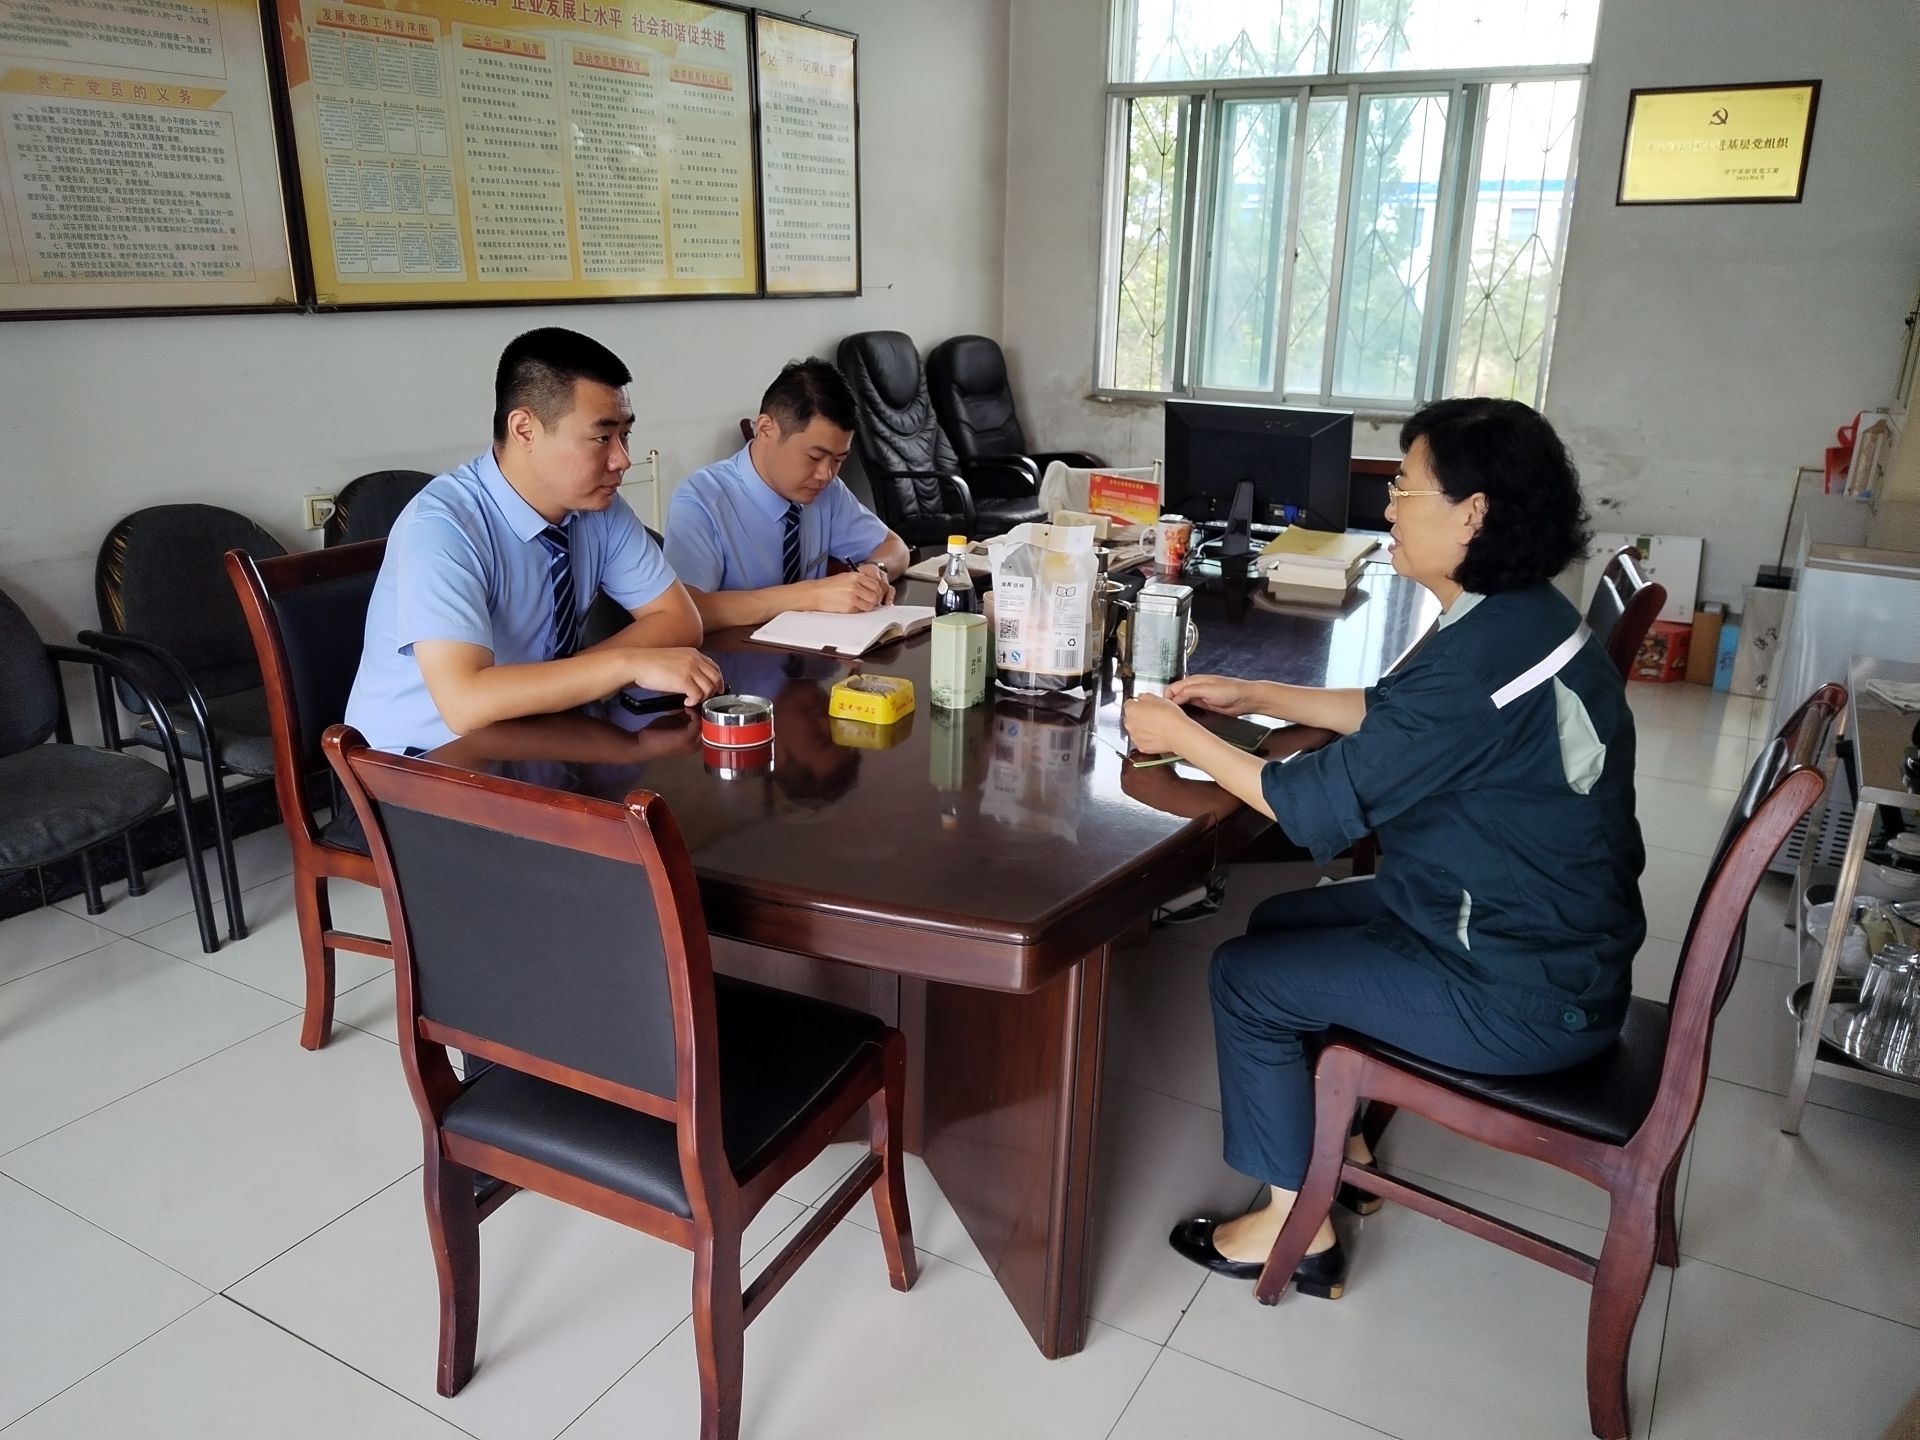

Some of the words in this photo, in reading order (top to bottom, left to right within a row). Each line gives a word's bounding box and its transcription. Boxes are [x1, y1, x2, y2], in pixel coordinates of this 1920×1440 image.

[321, 7, 428, 36] 发展党员工作程序图
[511, 0, 623, 30] 企业发展上水平
[631, 13, 727, 50] 社会和谐促共进
[36, 74, 193, 104] 共产党员的义务
